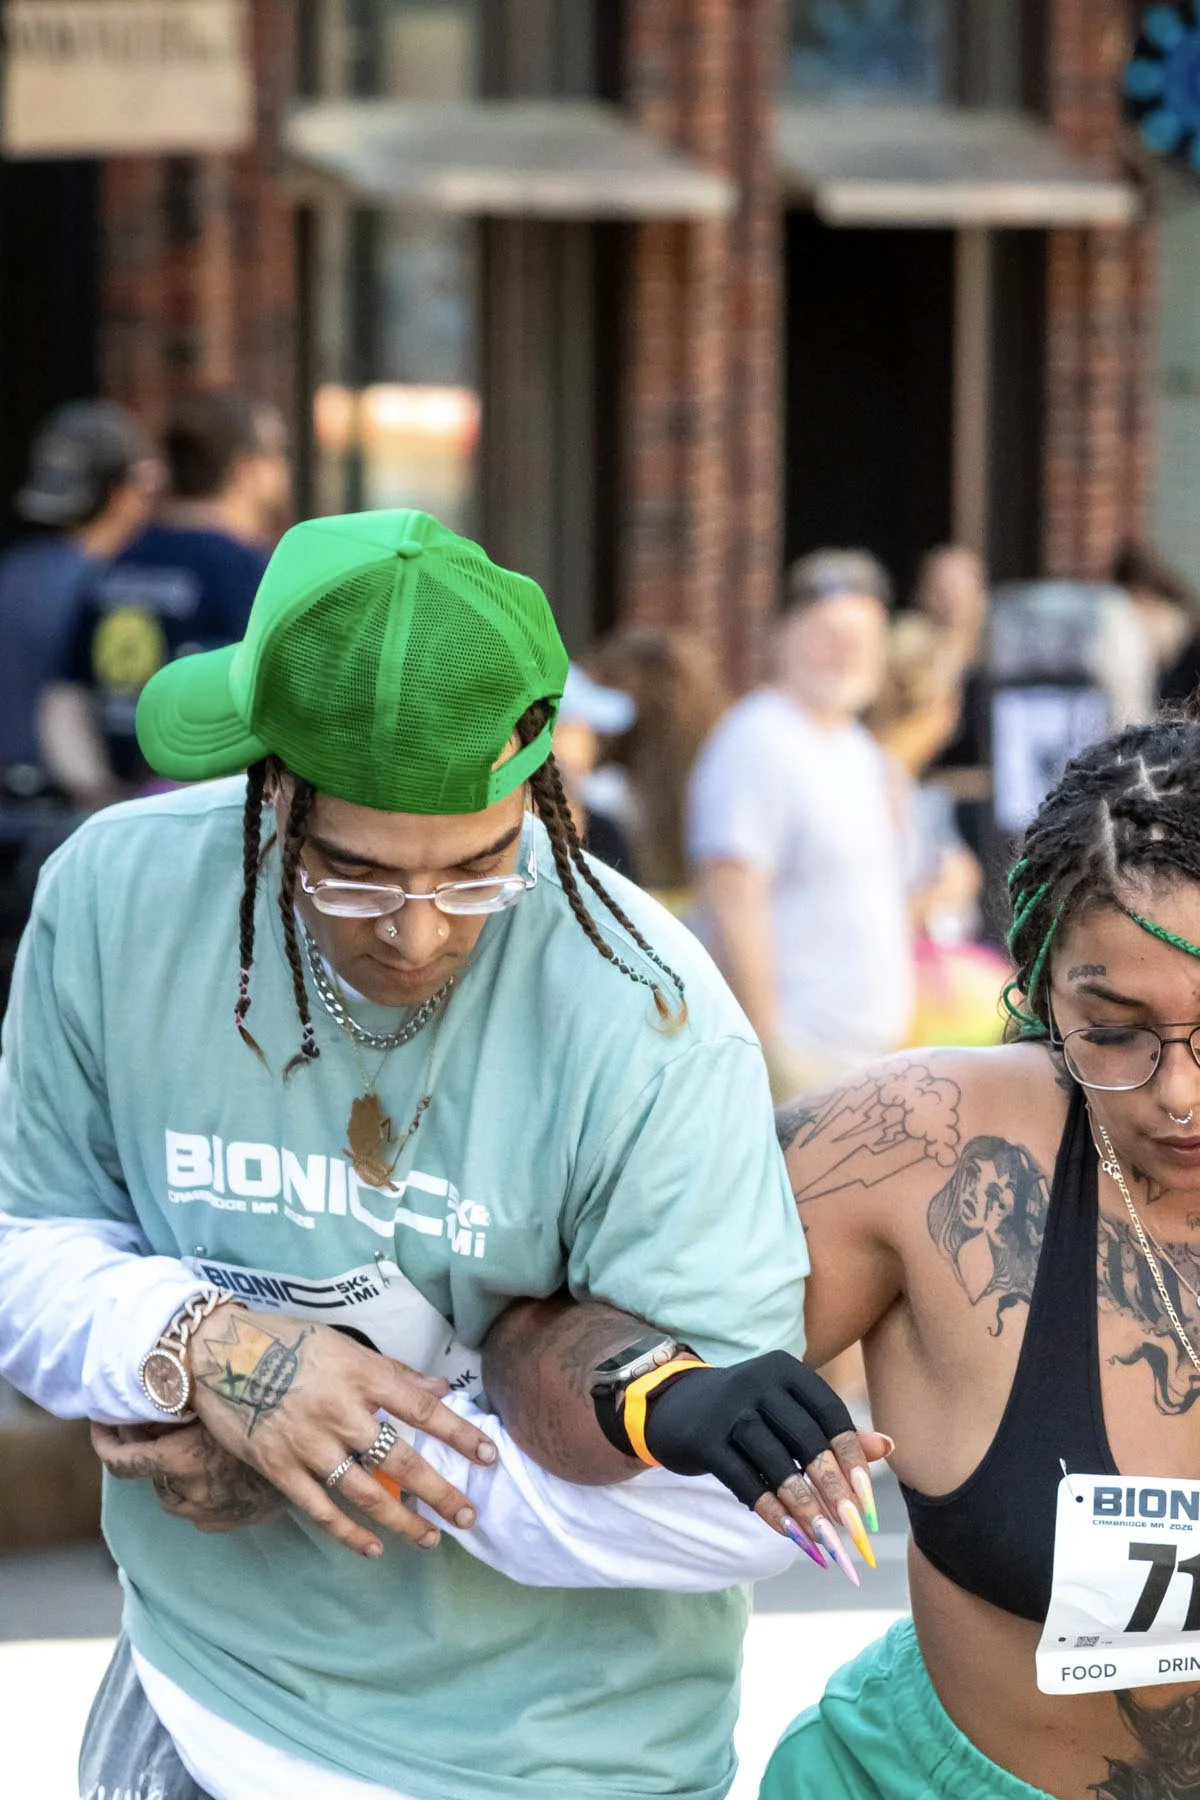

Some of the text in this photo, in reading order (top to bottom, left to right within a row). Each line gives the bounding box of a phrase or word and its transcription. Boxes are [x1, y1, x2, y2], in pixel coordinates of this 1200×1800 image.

[165, 1128, 450, 1238] BIONIC
[201, 1265, 346, 1308] BIONIC
[1092, 1520, 1147, 1529] CAMBRIDGE
[1061, 1663, 1117, 1681] FOOD
